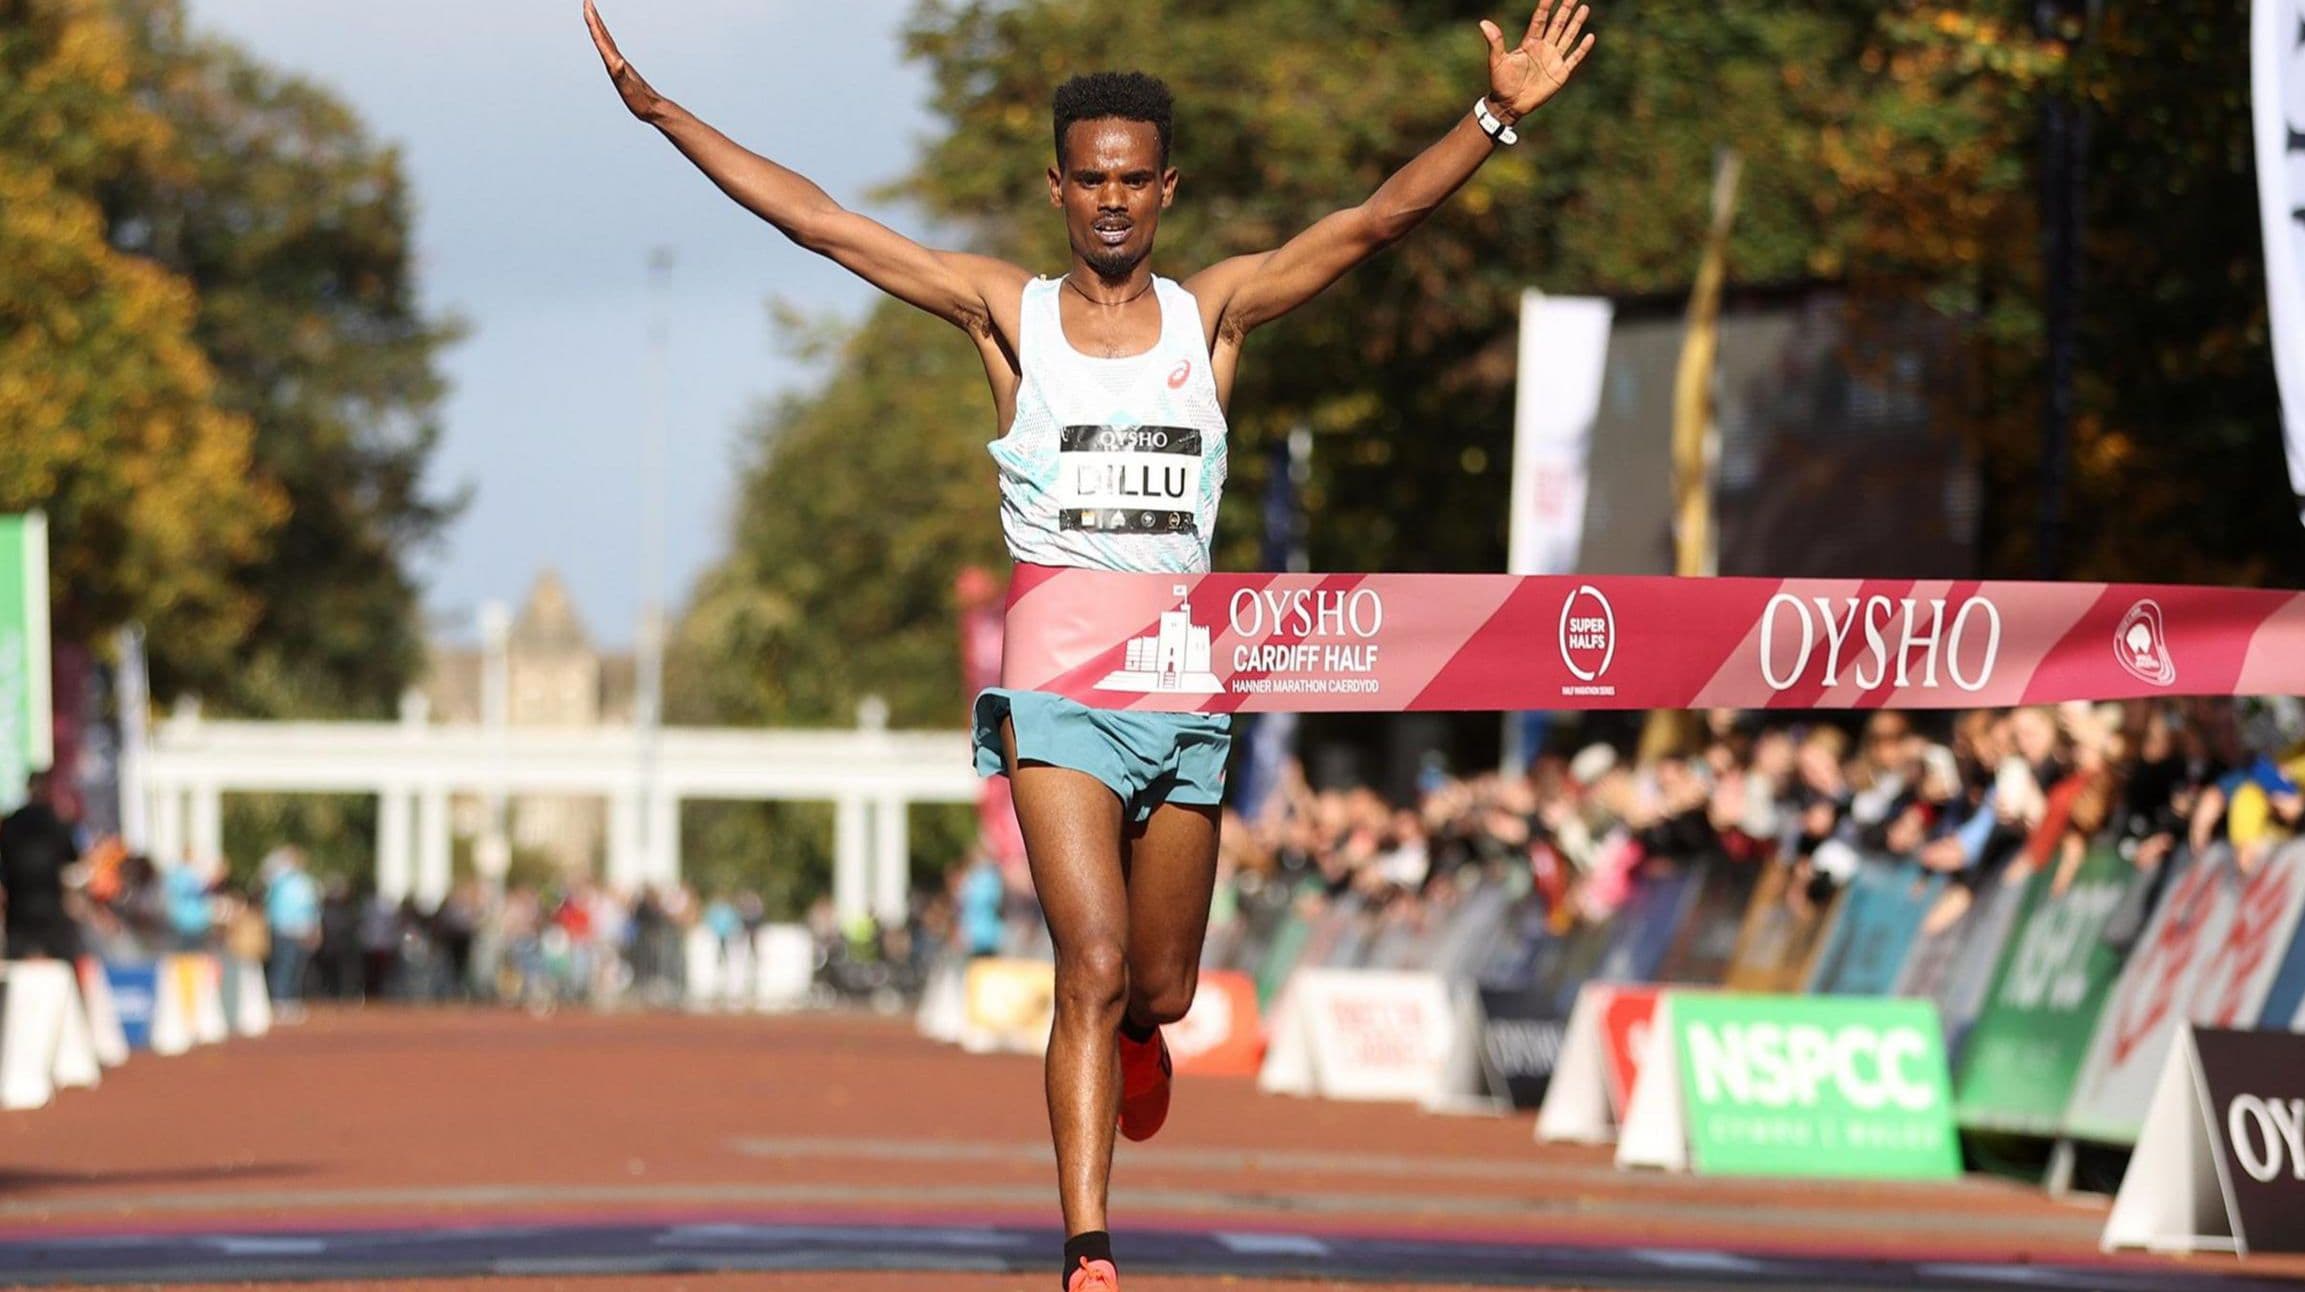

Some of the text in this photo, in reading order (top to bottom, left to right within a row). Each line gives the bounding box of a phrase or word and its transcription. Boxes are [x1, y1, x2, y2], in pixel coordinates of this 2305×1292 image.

[1099, 430, 1168, 448] OYSHO
[1229, 588, 1383, 638] OYSHO
[1569, 618, 1606, 633] SUPER
[1569, 634, 1606, 649] HALFS
[1760, 593, 2001, 691] OYSHO
[1233, 644, 1378, 672] CARDIFF HALF
[1232, 680, 1379, 693] HANNER MARATHON CAERDYDD
[1687, 1020, 1936, 1111] NSPCC
